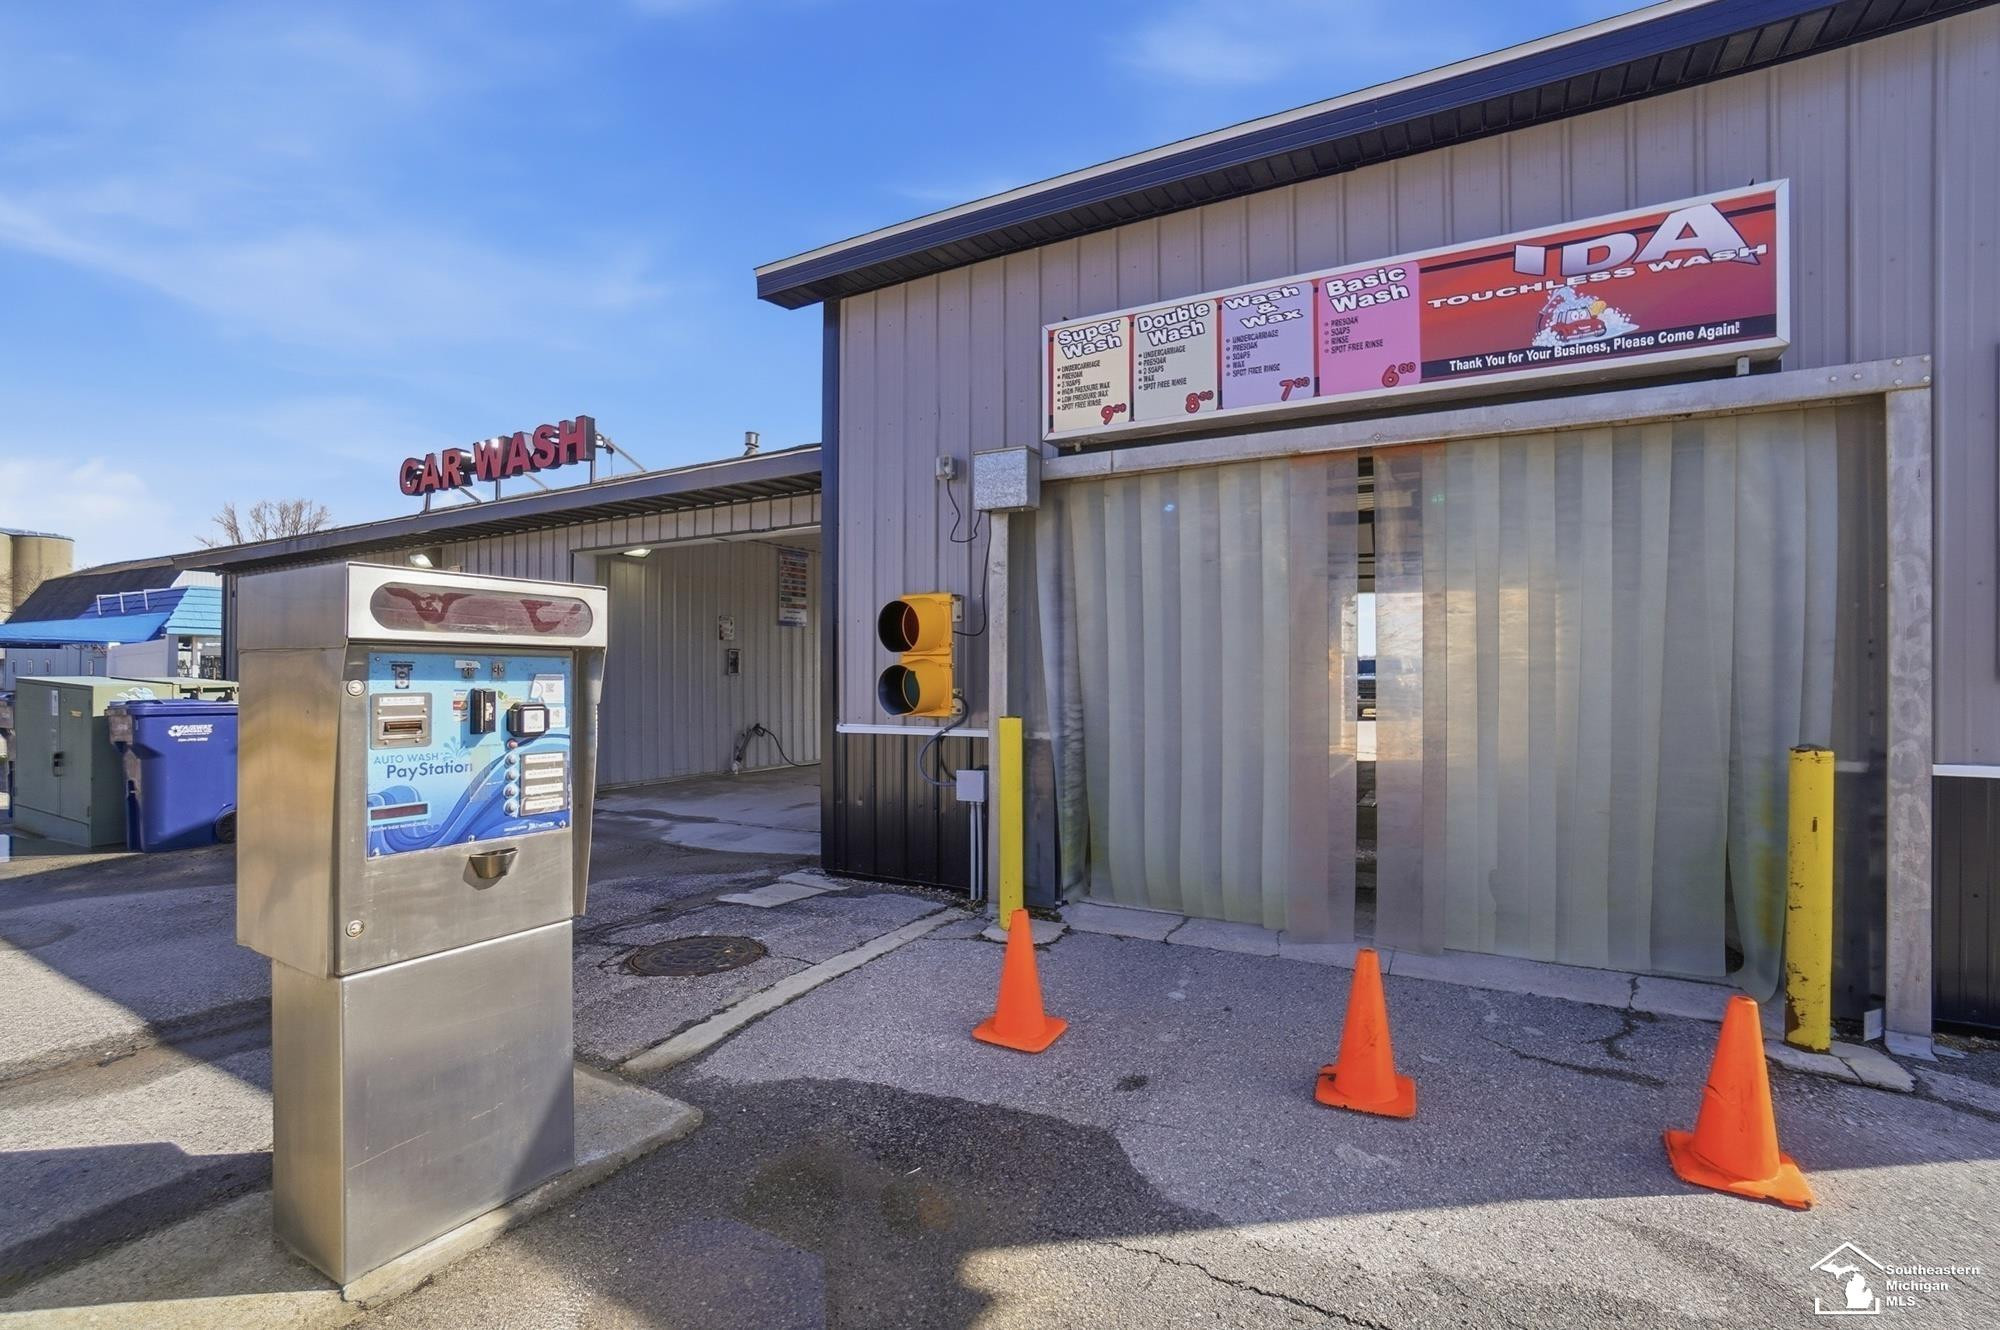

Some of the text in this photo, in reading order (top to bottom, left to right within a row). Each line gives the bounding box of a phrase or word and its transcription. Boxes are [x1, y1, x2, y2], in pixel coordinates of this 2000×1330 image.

[1513, 202, 1760, 277] IDA
[1325, 268, 1407, 297] Basic
[1427, 243, 1768, 309] TOUCHLESS WASH
[1224, 285, 1300, 310] Wash
[1257, 302, 1280, 315] &
[1331, 284, 1410, 313] Wash
[1138, 303, 1210, 333] Double
[1240, 309, 1304, 329] Wax
[1058, 319, 1121, 346] Super
[1147, 320, 1205, 347] Wash
[1331, 327, 1350, 336] SOAPS
[1331, 335, 1349, 345] RINSE
[1062, 335, 1122, 360] Wash
[1331, 339, 1383, 354] SPOT FREE RINSE
[1449, 321, 1740, 372] Thank You for Your Business, Please Come Again!
[400, 415, 595, 496] CAR WASH
[373, 752, 439, 765] AUTO WASH
[386, 760, 473, 782] PayStation
